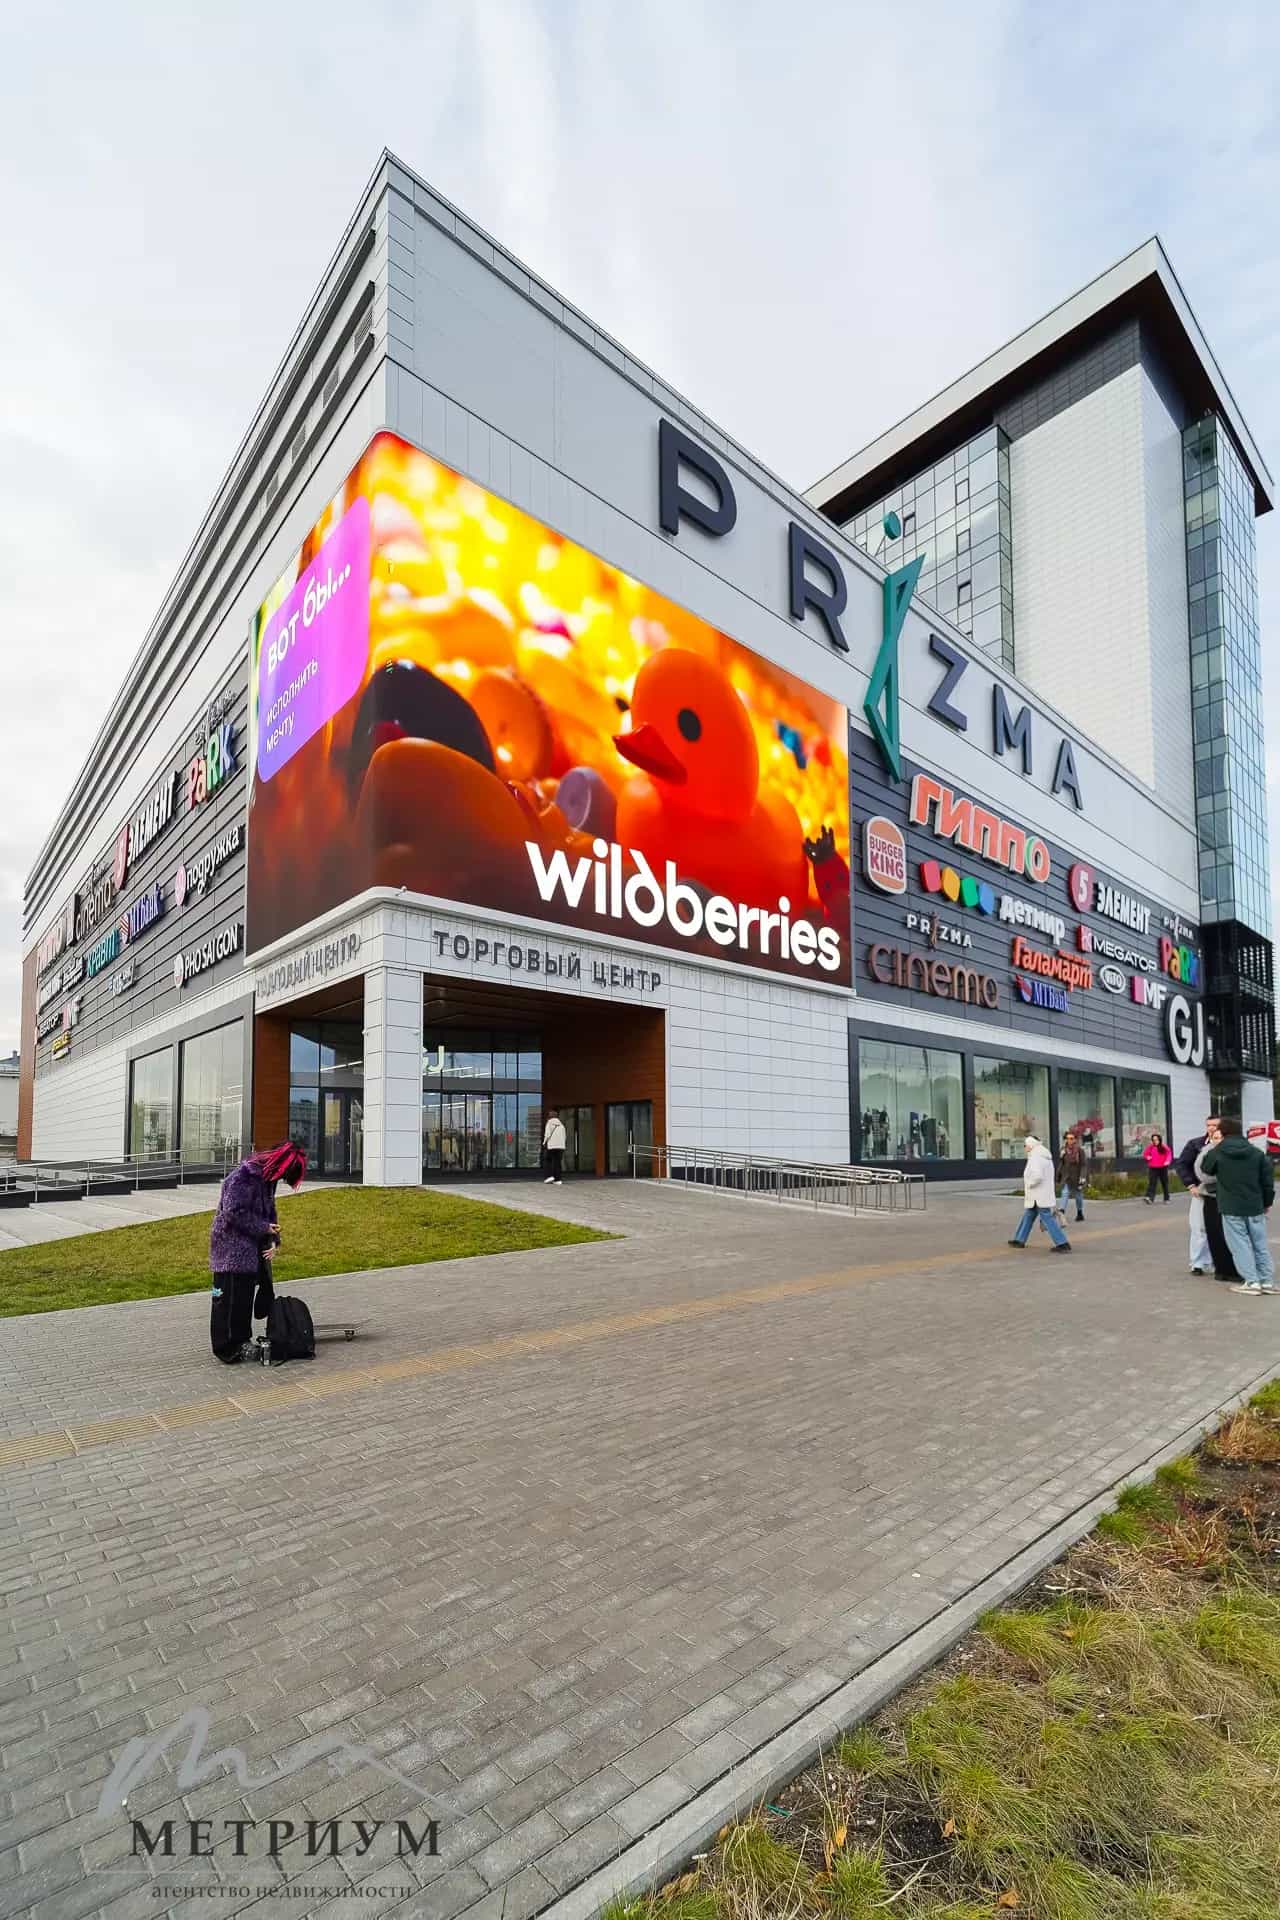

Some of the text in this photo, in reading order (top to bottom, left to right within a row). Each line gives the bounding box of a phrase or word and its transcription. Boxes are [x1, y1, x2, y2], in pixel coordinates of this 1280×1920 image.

[266, 658, 318, 726] исполнить
[265, 711, 295, 753] мечту
[127, 771, 176, 866] ЭЛЕМЕНТ
[910, 774, 1050, 882] ГИППО
[186, 825, 240, 895] подружка
[869, 836, 904, 860] BURGER
[869, 851, 904, 880] KING
[526, 838, 841, 972] wildberries
[1000, 895, 1065, 945] детмир
[1097, 881, 1150, 935] ЭЛЕМЕНТ
[184, 948, 202, 979] PHO
[255, 933, 360, 998] ТОРГОВЫЙ ЦЕНТР
[433, 929, 661, 992] ТОРГОВЫЙ ЦЕНТР
[1013, 936, 1092, 992] Галамарт
[1093, 938, 1157, 972] MEGATOP
[1144, 979, 1167, 1010] MF
[1170, 995, 1204, 1066] GJ
